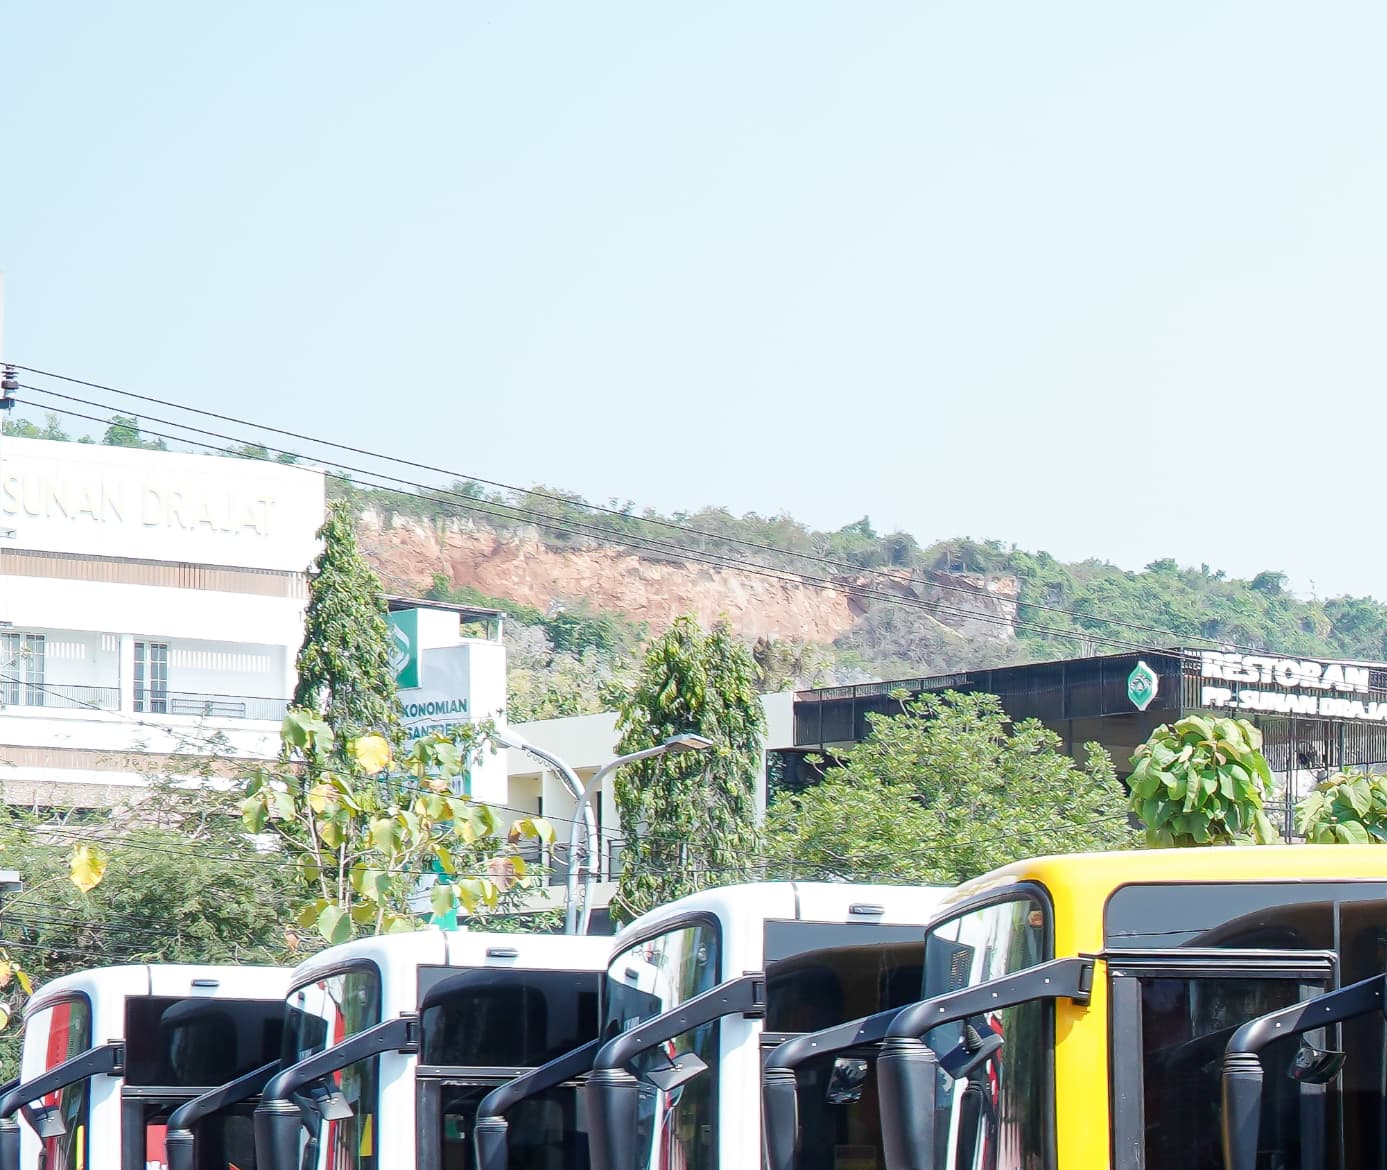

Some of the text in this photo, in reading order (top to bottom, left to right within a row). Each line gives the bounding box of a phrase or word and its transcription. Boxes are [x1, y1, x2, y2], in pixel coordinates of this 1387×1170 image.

[2, 473, 279, 537] SUNAN DRAJAT
[1201, 651, 1369, 693] RESTORAN
[402, 698, 468, 718] KONOMIAN
[1239, 691, 1318, 715] SUNAN
